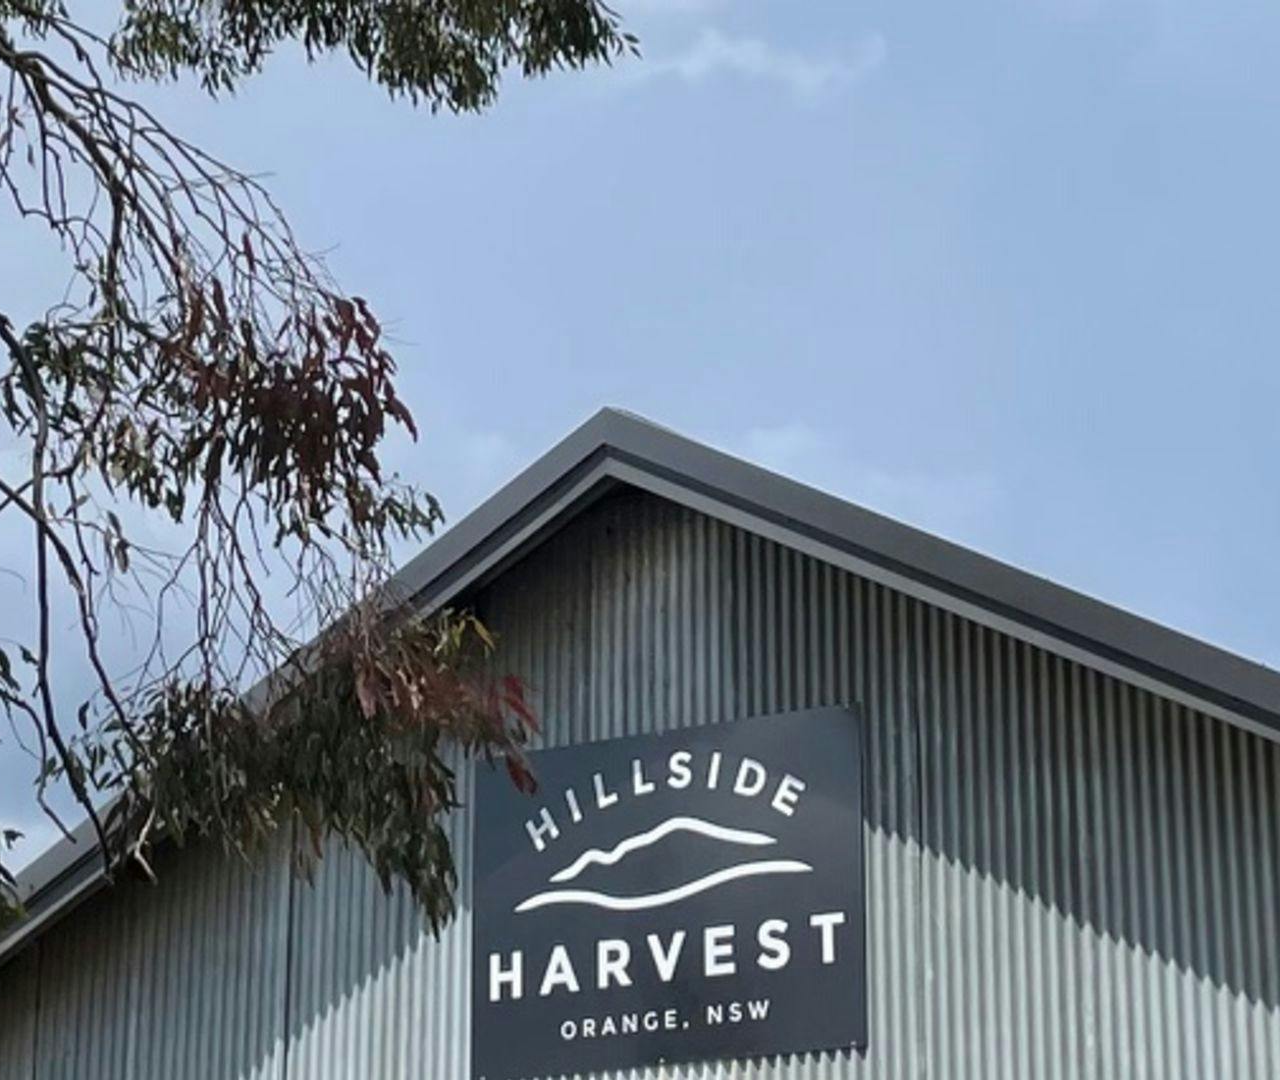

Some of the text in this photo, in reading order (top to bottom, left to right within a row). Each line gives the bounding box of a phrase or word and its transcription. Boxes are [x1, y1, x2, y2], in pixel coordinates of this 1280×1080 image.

[525, 751, 806, 852] HILLSIDE
[489, 911, 846, 1002] HARVEST
[707, 1000, 770, 1025] NSW
